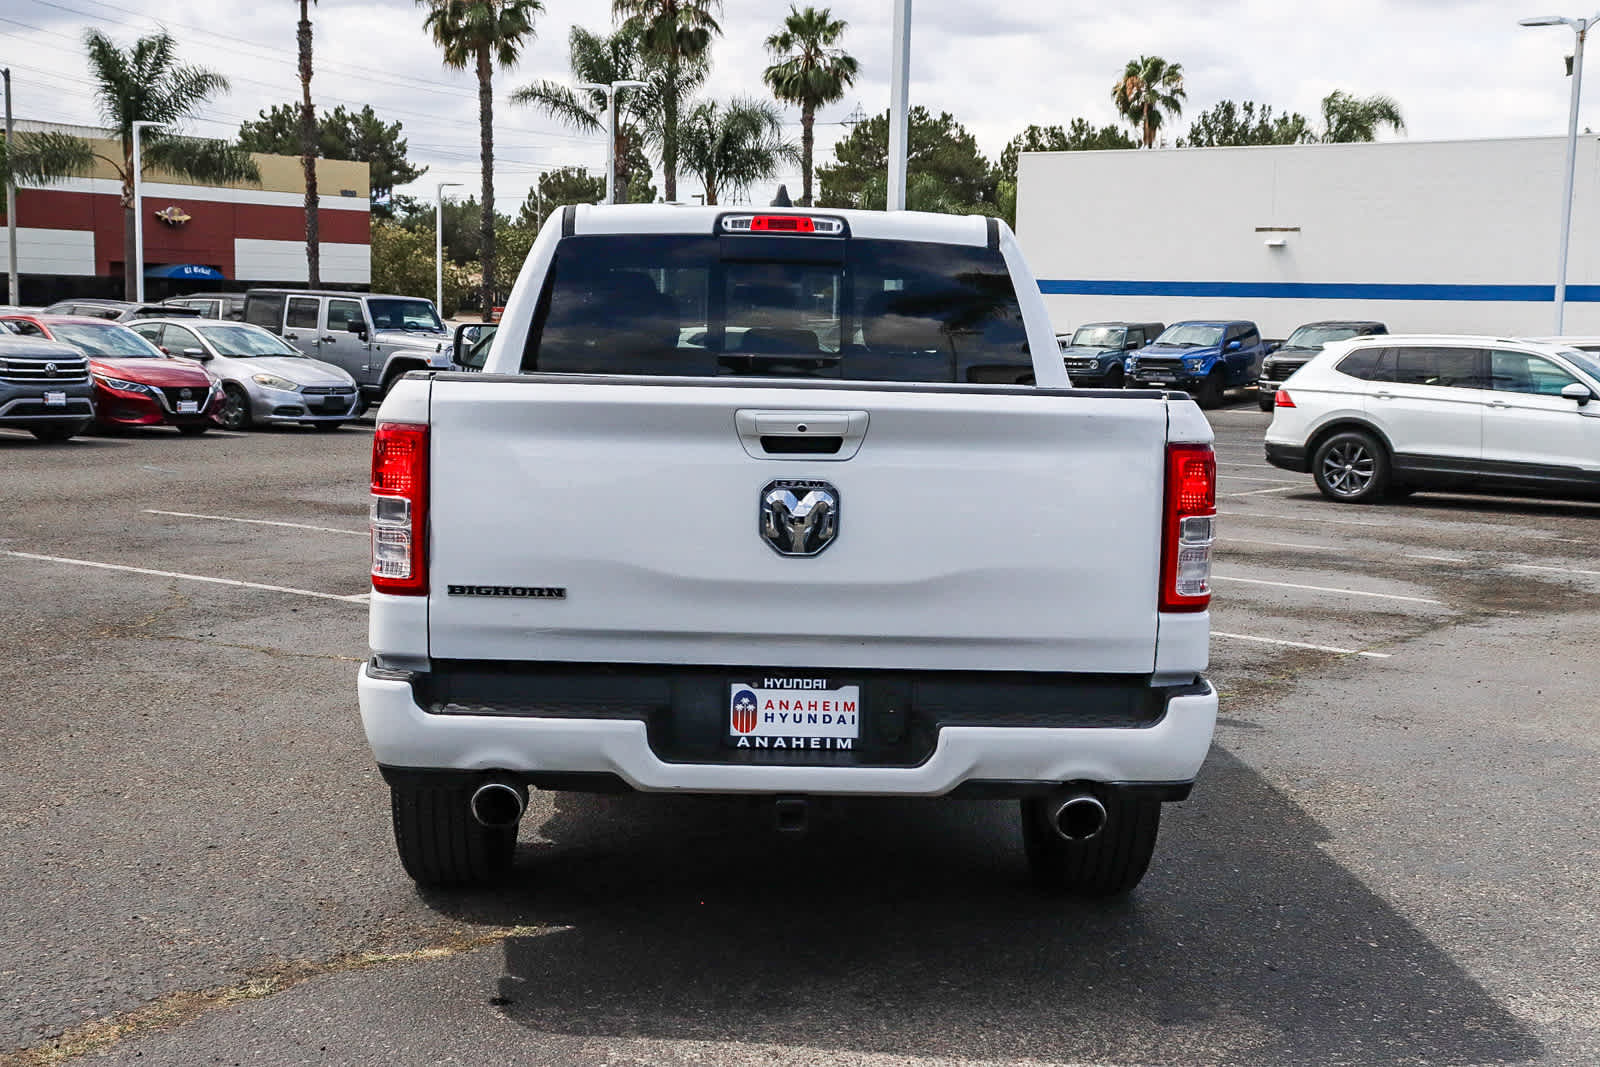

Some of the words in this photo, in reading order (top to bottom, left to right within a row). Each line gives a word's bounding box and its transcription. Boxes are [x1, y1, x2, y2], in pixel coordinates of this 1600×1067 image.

[776, 480, 825, 488] RAM
[447, 585, 567, 599] BIGHORN
[764, 678, 827, 689] HYUNDAI
[764, 700, 856, 712] ANAHEIM
[764, 713, 856, 725] HYUNDAI
[736, 736, 853, 749] ANAHEIM
